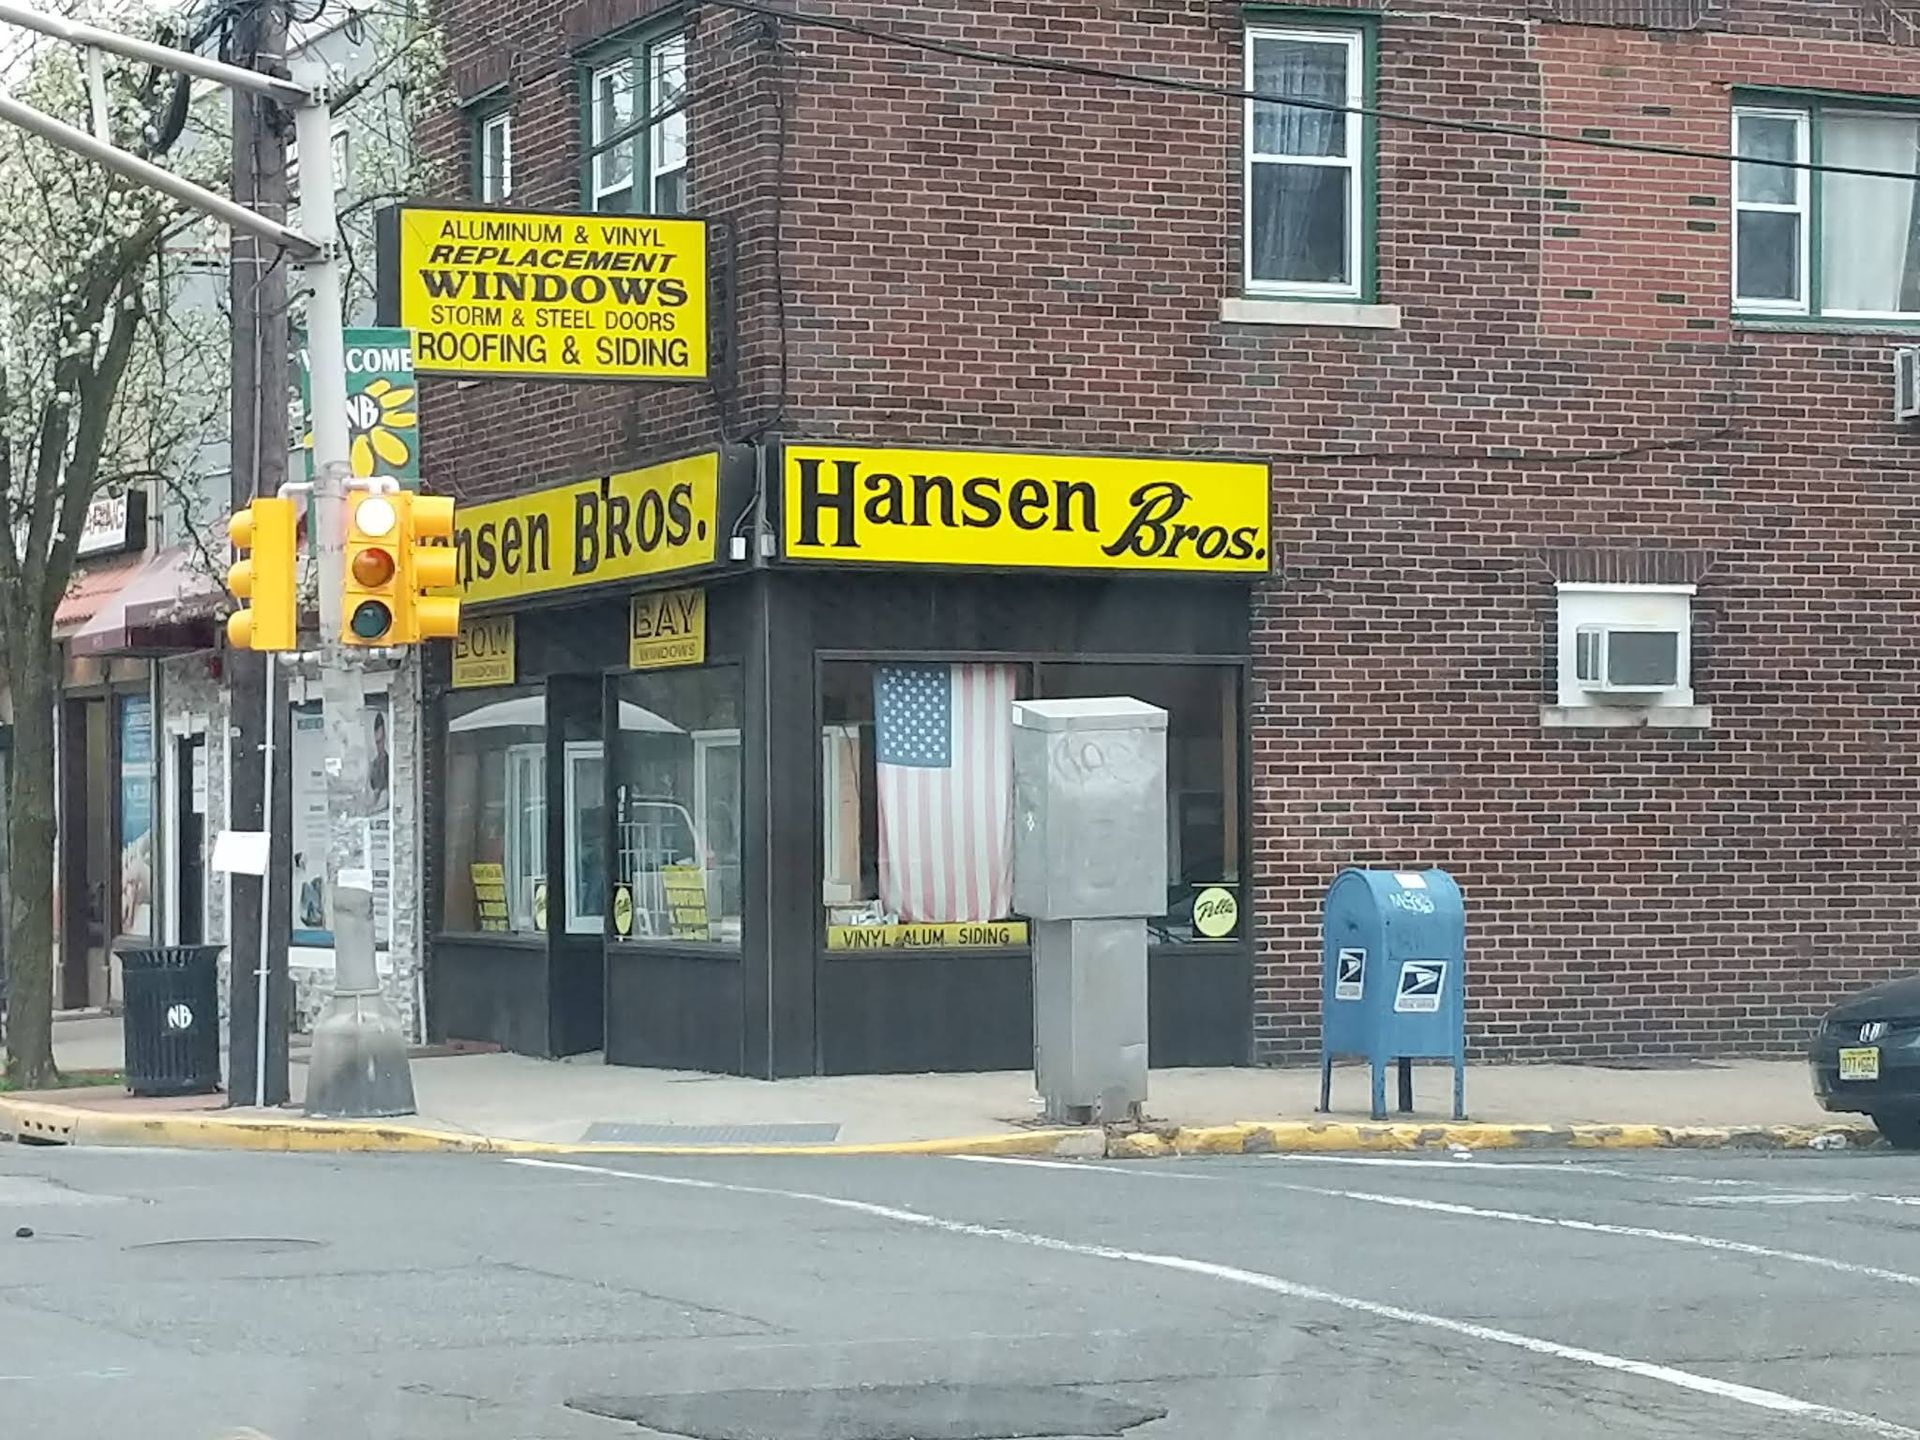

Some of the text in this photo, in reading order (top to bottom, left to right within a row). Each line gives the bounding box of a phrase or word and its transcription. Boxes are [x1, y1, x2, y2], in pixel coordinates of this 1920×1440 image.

[440, 220, 666, 247] ALUMINUM & VINYL
[428, 244, 677, 273] REPLACEMENT
[419, 269, 689, 307] WINDOWS
[431, 305, 676, 332] STORM & STEEL DOORS
[417, 331, 689, 368] ROOFING & SIDING
[794, 458, 1266, 561] Hansen Bros.
[633, 593, 698, 640] BAY
[843, 930, 891, 948] VINYL
[958, 927, 1010, 945] SIDING
[167, 1003, 193, 1029] NB
